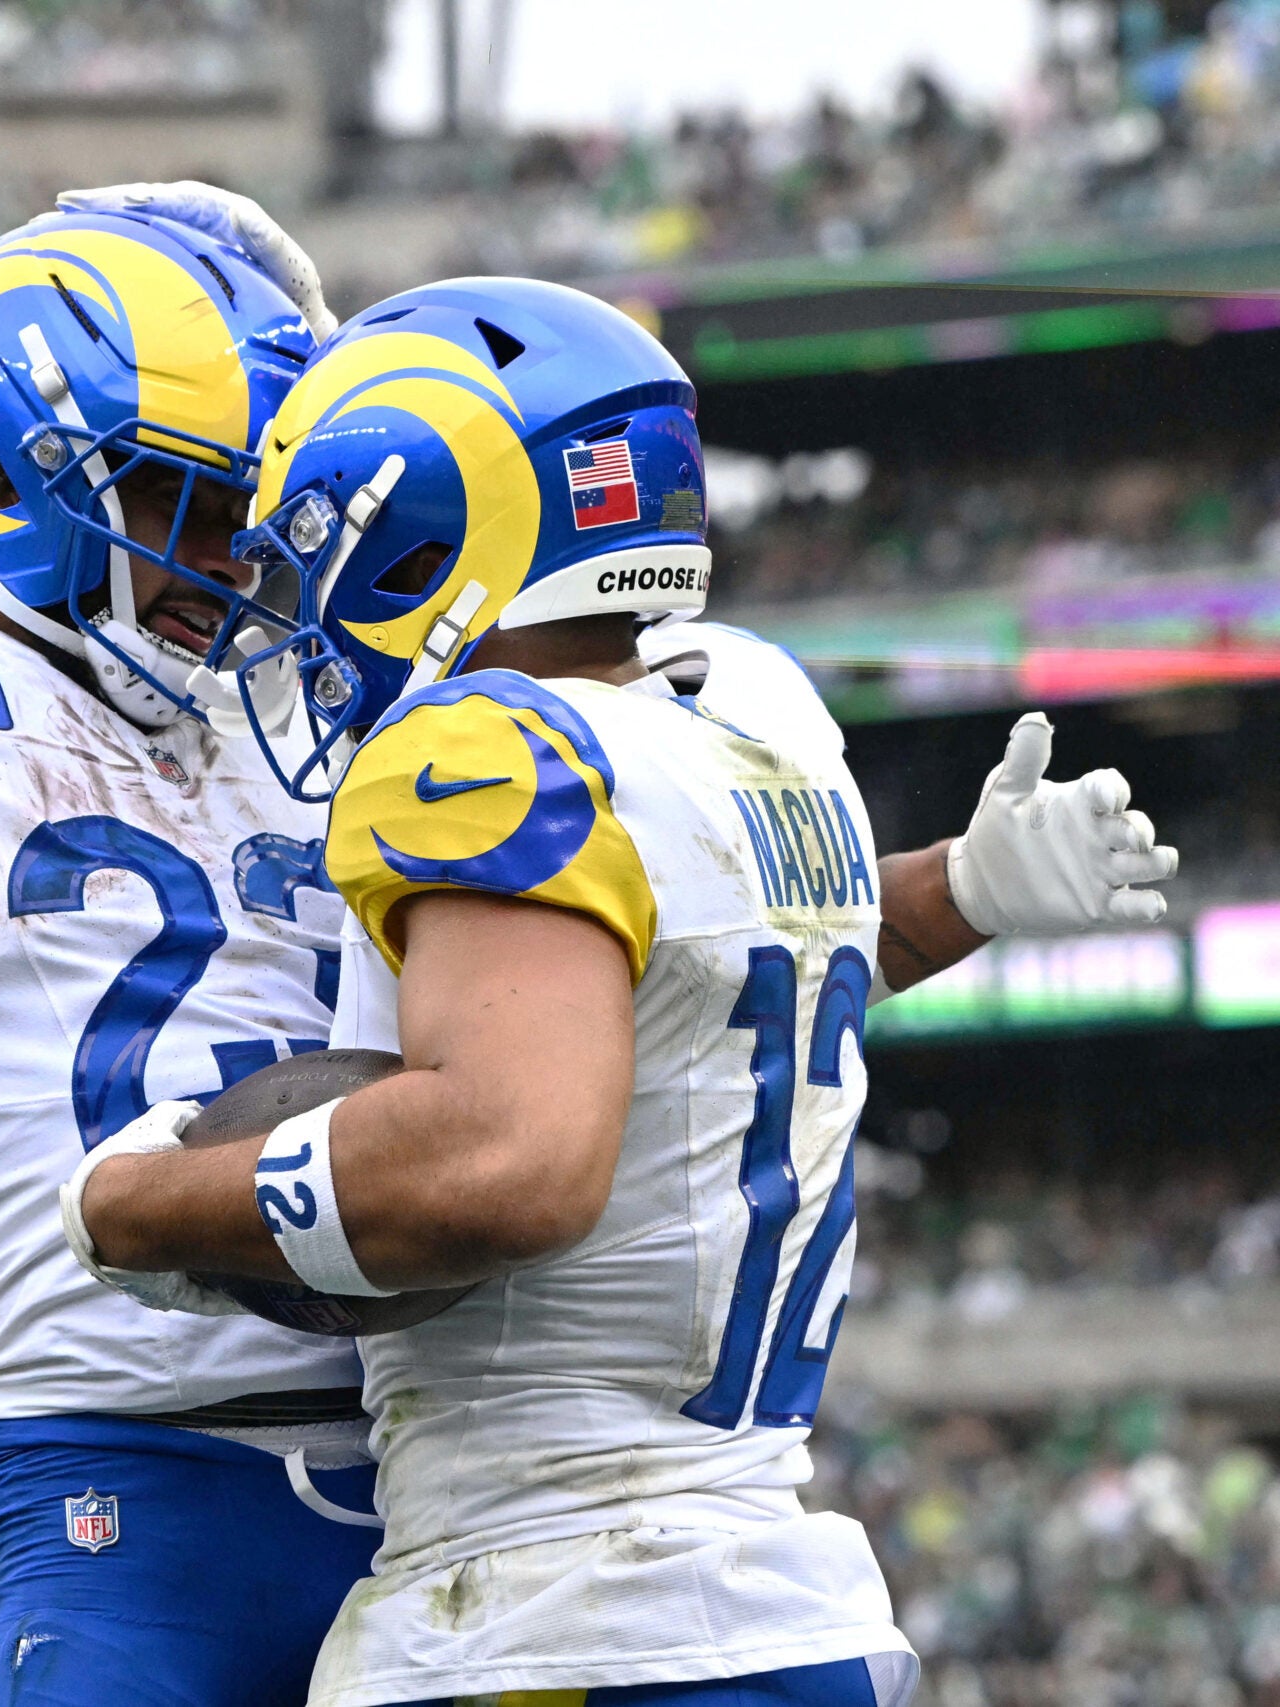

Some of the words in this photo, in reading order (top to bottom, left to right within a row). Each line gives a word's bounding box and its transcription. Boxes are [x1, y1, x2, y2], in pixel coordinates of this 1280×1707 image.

[596, 567, 696, 594] CHOOSE
[697, 569, 709, 593] LO
[728, 789, 876, 909] NACUA
[255, 1141, 318, 1236] 12
[679, 944, 872, 1431] 12
[75, 1516, 112, 1542] NFL
